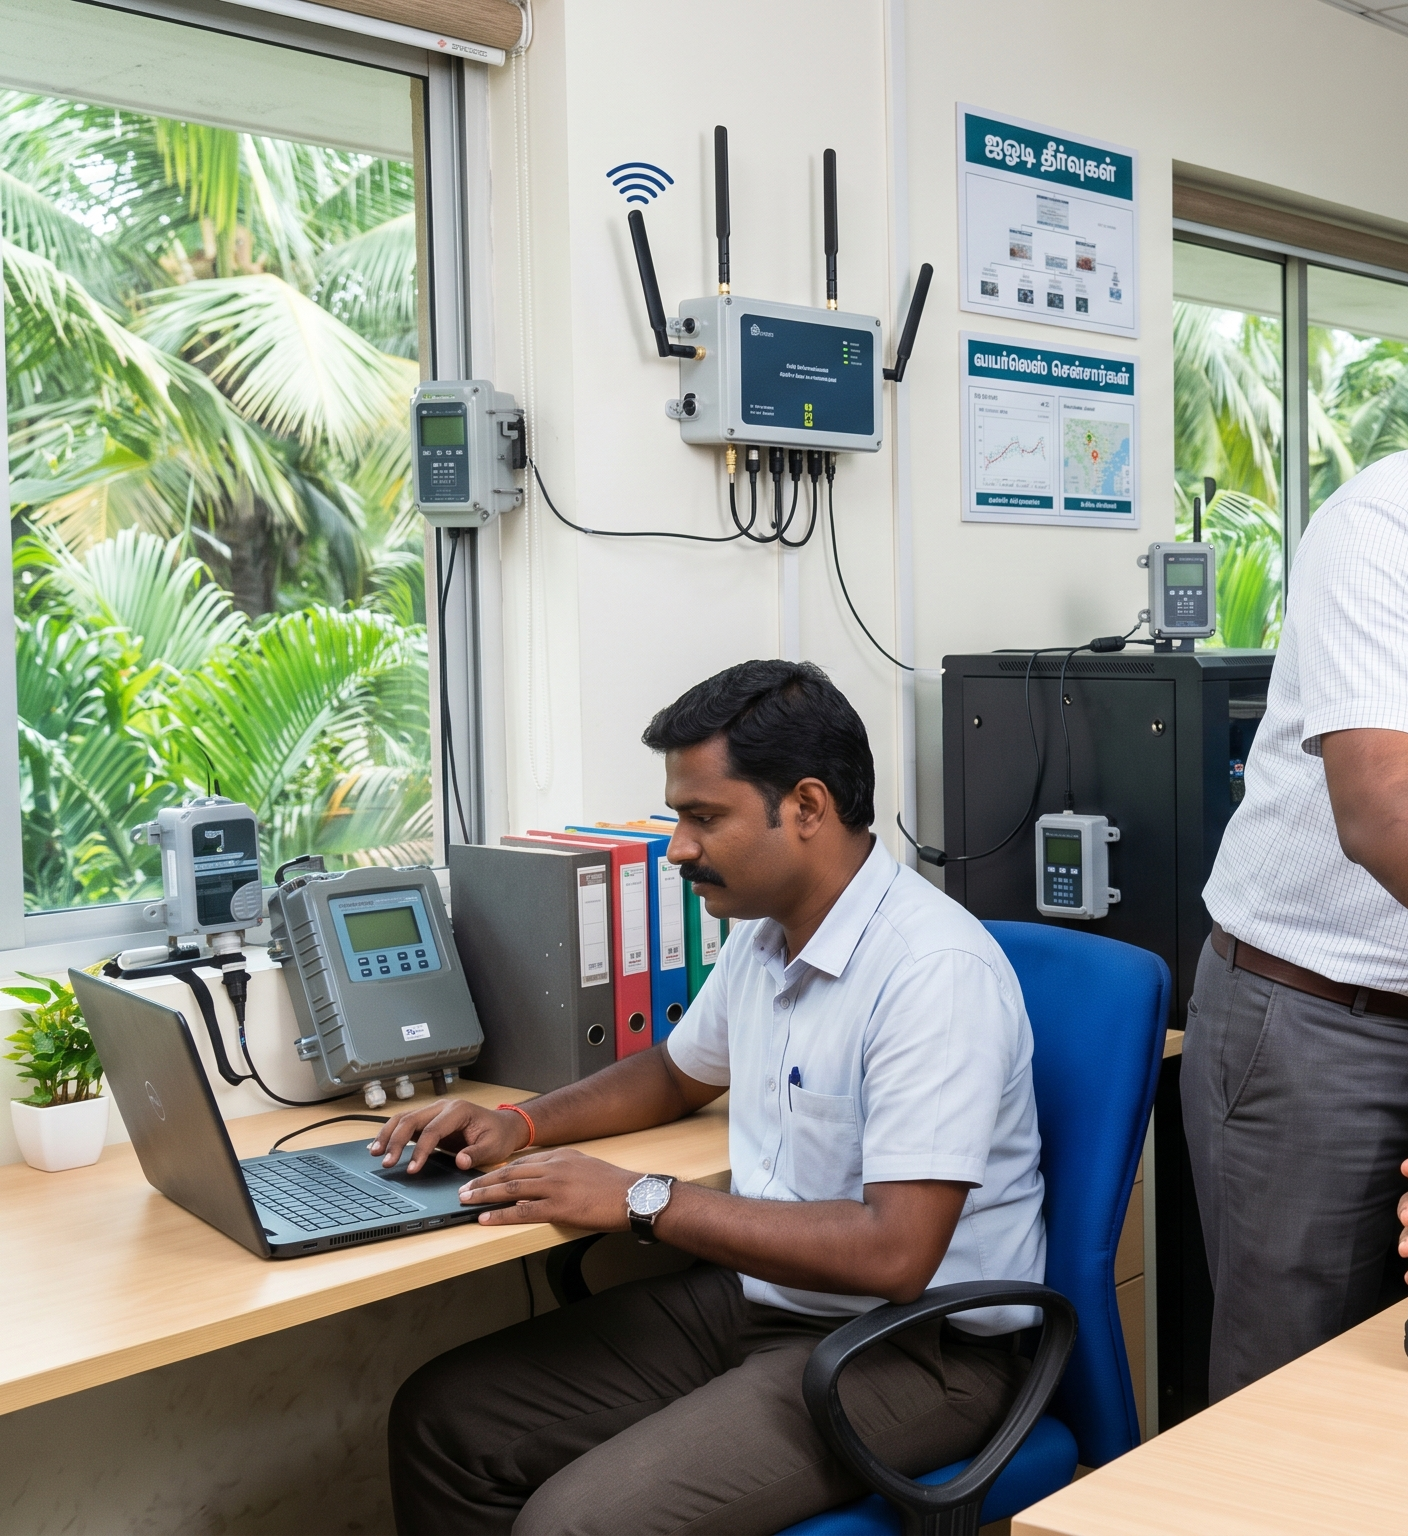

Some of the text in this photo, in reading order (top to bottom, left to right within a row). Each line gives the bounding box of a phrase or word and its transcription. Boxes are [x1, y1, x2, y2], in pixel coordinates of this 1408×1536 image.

[985, 134, 1117, 183] ஐஓடி தீர்வுகள்
[974, 351, 1130, 386] வயர்லெஸ் சென்சார்கள்
